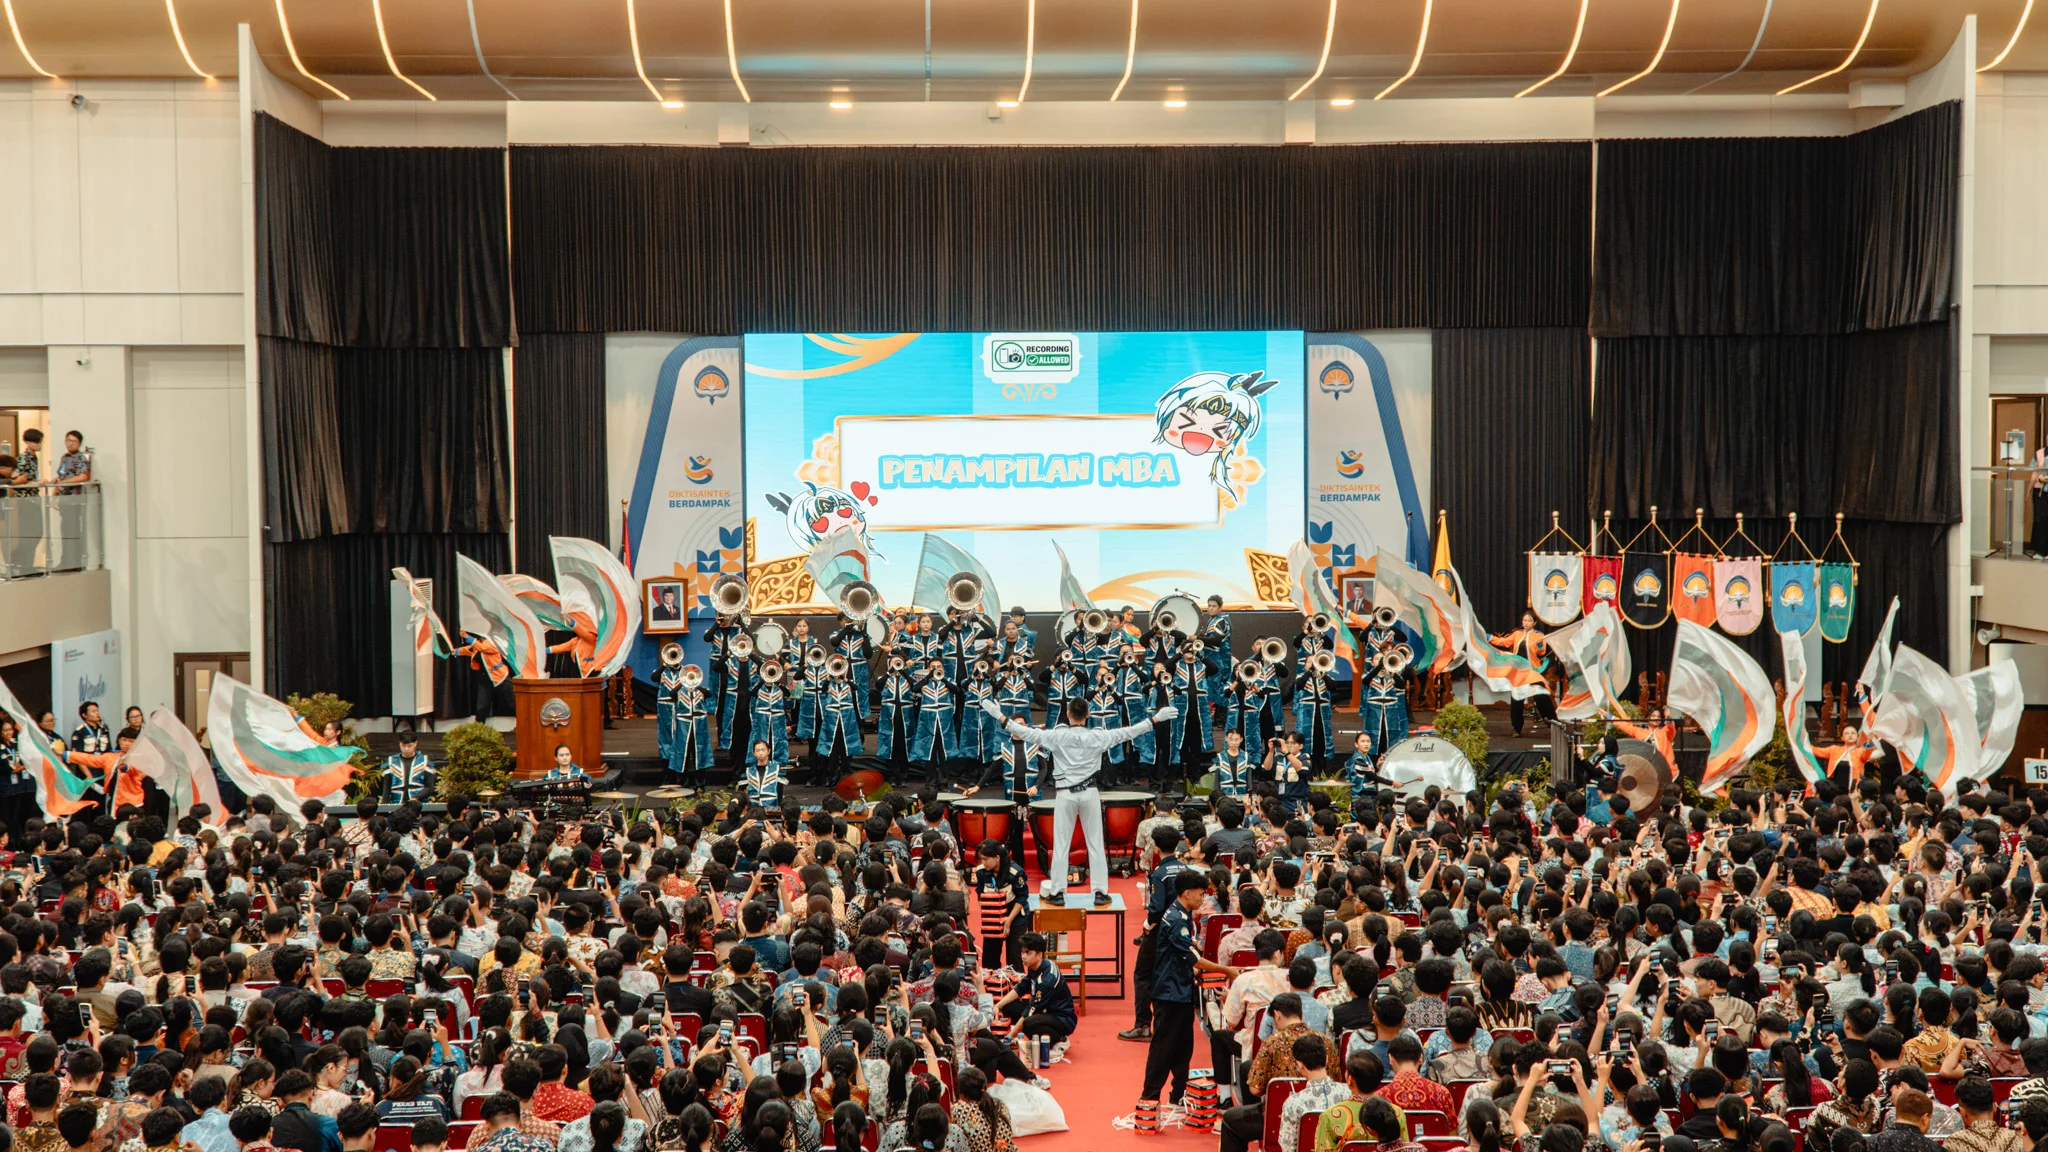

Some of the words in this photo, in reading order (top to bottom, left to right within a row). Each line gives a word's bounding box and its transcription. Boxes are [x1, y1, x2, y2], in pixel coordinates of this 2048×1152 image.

[1026, 345, 1070, 353] RECORDING
[1038, 356, 1069, 364] ALLOWED
[881, 454, 1092, 487] PENAMPILAN
[1101, 454, 1178, 485] MBA
[1319, 484, 1381, 492] DIKTISAINTEK
[669, 490, 730, 498] DIKTISAINTEK
[1320, 493, 1381, 502] BERDAMPAK
[669, 499, 731, 508] BERDAMPAK
